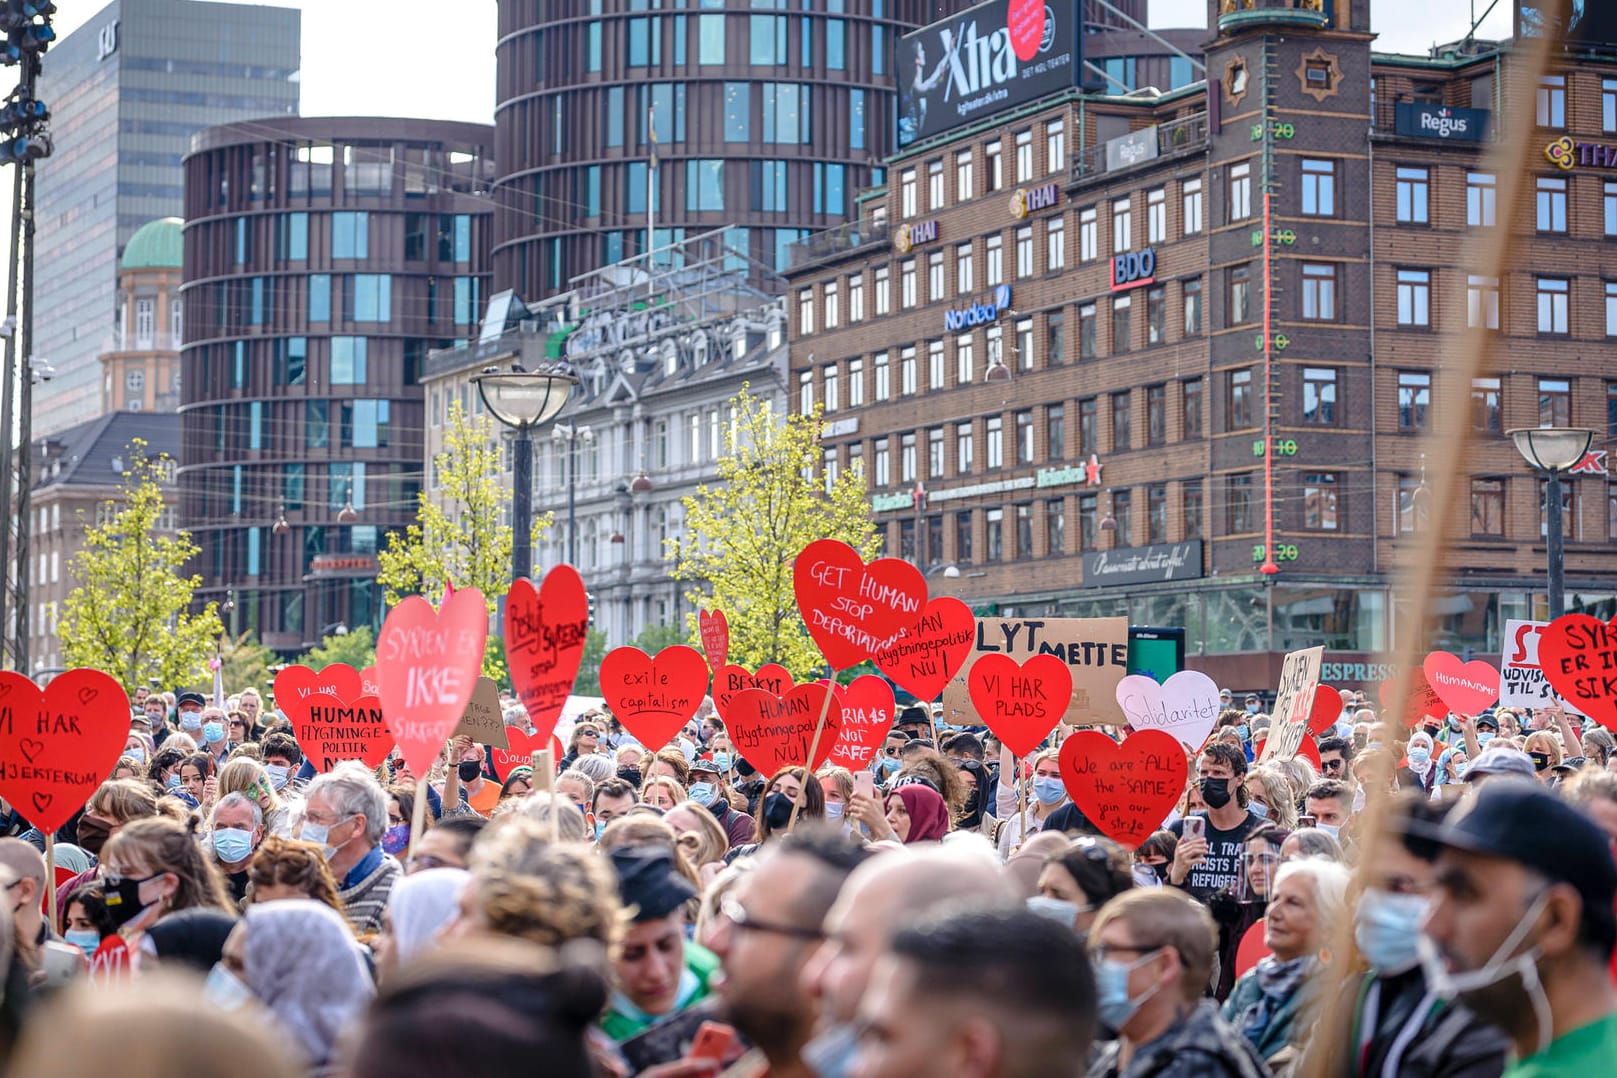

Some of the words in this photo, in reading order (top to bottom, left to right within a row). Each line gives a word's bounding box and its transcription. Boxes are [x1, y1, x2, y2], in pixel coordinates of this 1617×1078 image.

[939, 20, 1017, 103] Xtra
[1275, 123, 1295, 139] 20
[1421, 111, 1468, 137] Regus
[1026, 184, 1059, 211] THAI
[910, 219, 939, 243] THAI
[1276, 229, 1297, 246] 10
[1114, 248, 1156, 284] BDO
[944, 302, 997, 332] Nordea
[1278, 439, 1298, 457] 10
[1278, 544, 1299, 561] 20
[810, 560, 852, 590] GET
[859, 571, 920, 613] HUMAN
[830, 596, 874, 621] STOP
[976, 621, 1045, 653] LYT
[1565, 623, 1617, 650] SYR
[1039, 641, 1127, 667] METTE
[1560, 654, 1590, 675] ER
[624, 667, 669, 686] exile
[1322, 662, 1402, 682] ESPRESS
[1503, 668, 1548, 684] UDVIS
[405, 666, 465, 708] IKKE
[982, 674, 1000, 695] VI
[1011, 677, 1047, 700] HAR
[1435, 671, 1497, 697] HUMANISME
[1507, 682, 1534, 696] TIL
[1575, 677, 1617, 699] SIK
[620, 692, 689, 710] capitalism
[759, 694, 810, 720] HUMAN
[995, 701, 1047, 718] PLADS
[1123, 694, 1218, 728] Solidaritet
[37, 711, 82, 735] HAR
[310, 705, 383, 724] HUMAN
[839, 729, 868, 743] NOT
[322, 742, 368, 754] POLITIK
[498, 748, 531, 765] SOLID
[832, 744, 873, 761] SAFE
[1073, 756, 1097, 775] We
[1109, 761, 1134, 772] are
[1145, 754, 1176, 773] ALL
[1094, 778, 1115, 794] the
[1126, 780, 1167, 796] SAME
[1098, 802, 1120, 820] join
[1128, 804, 1150, 815] our
[1191, 857, 1230, 872] ACISTS
